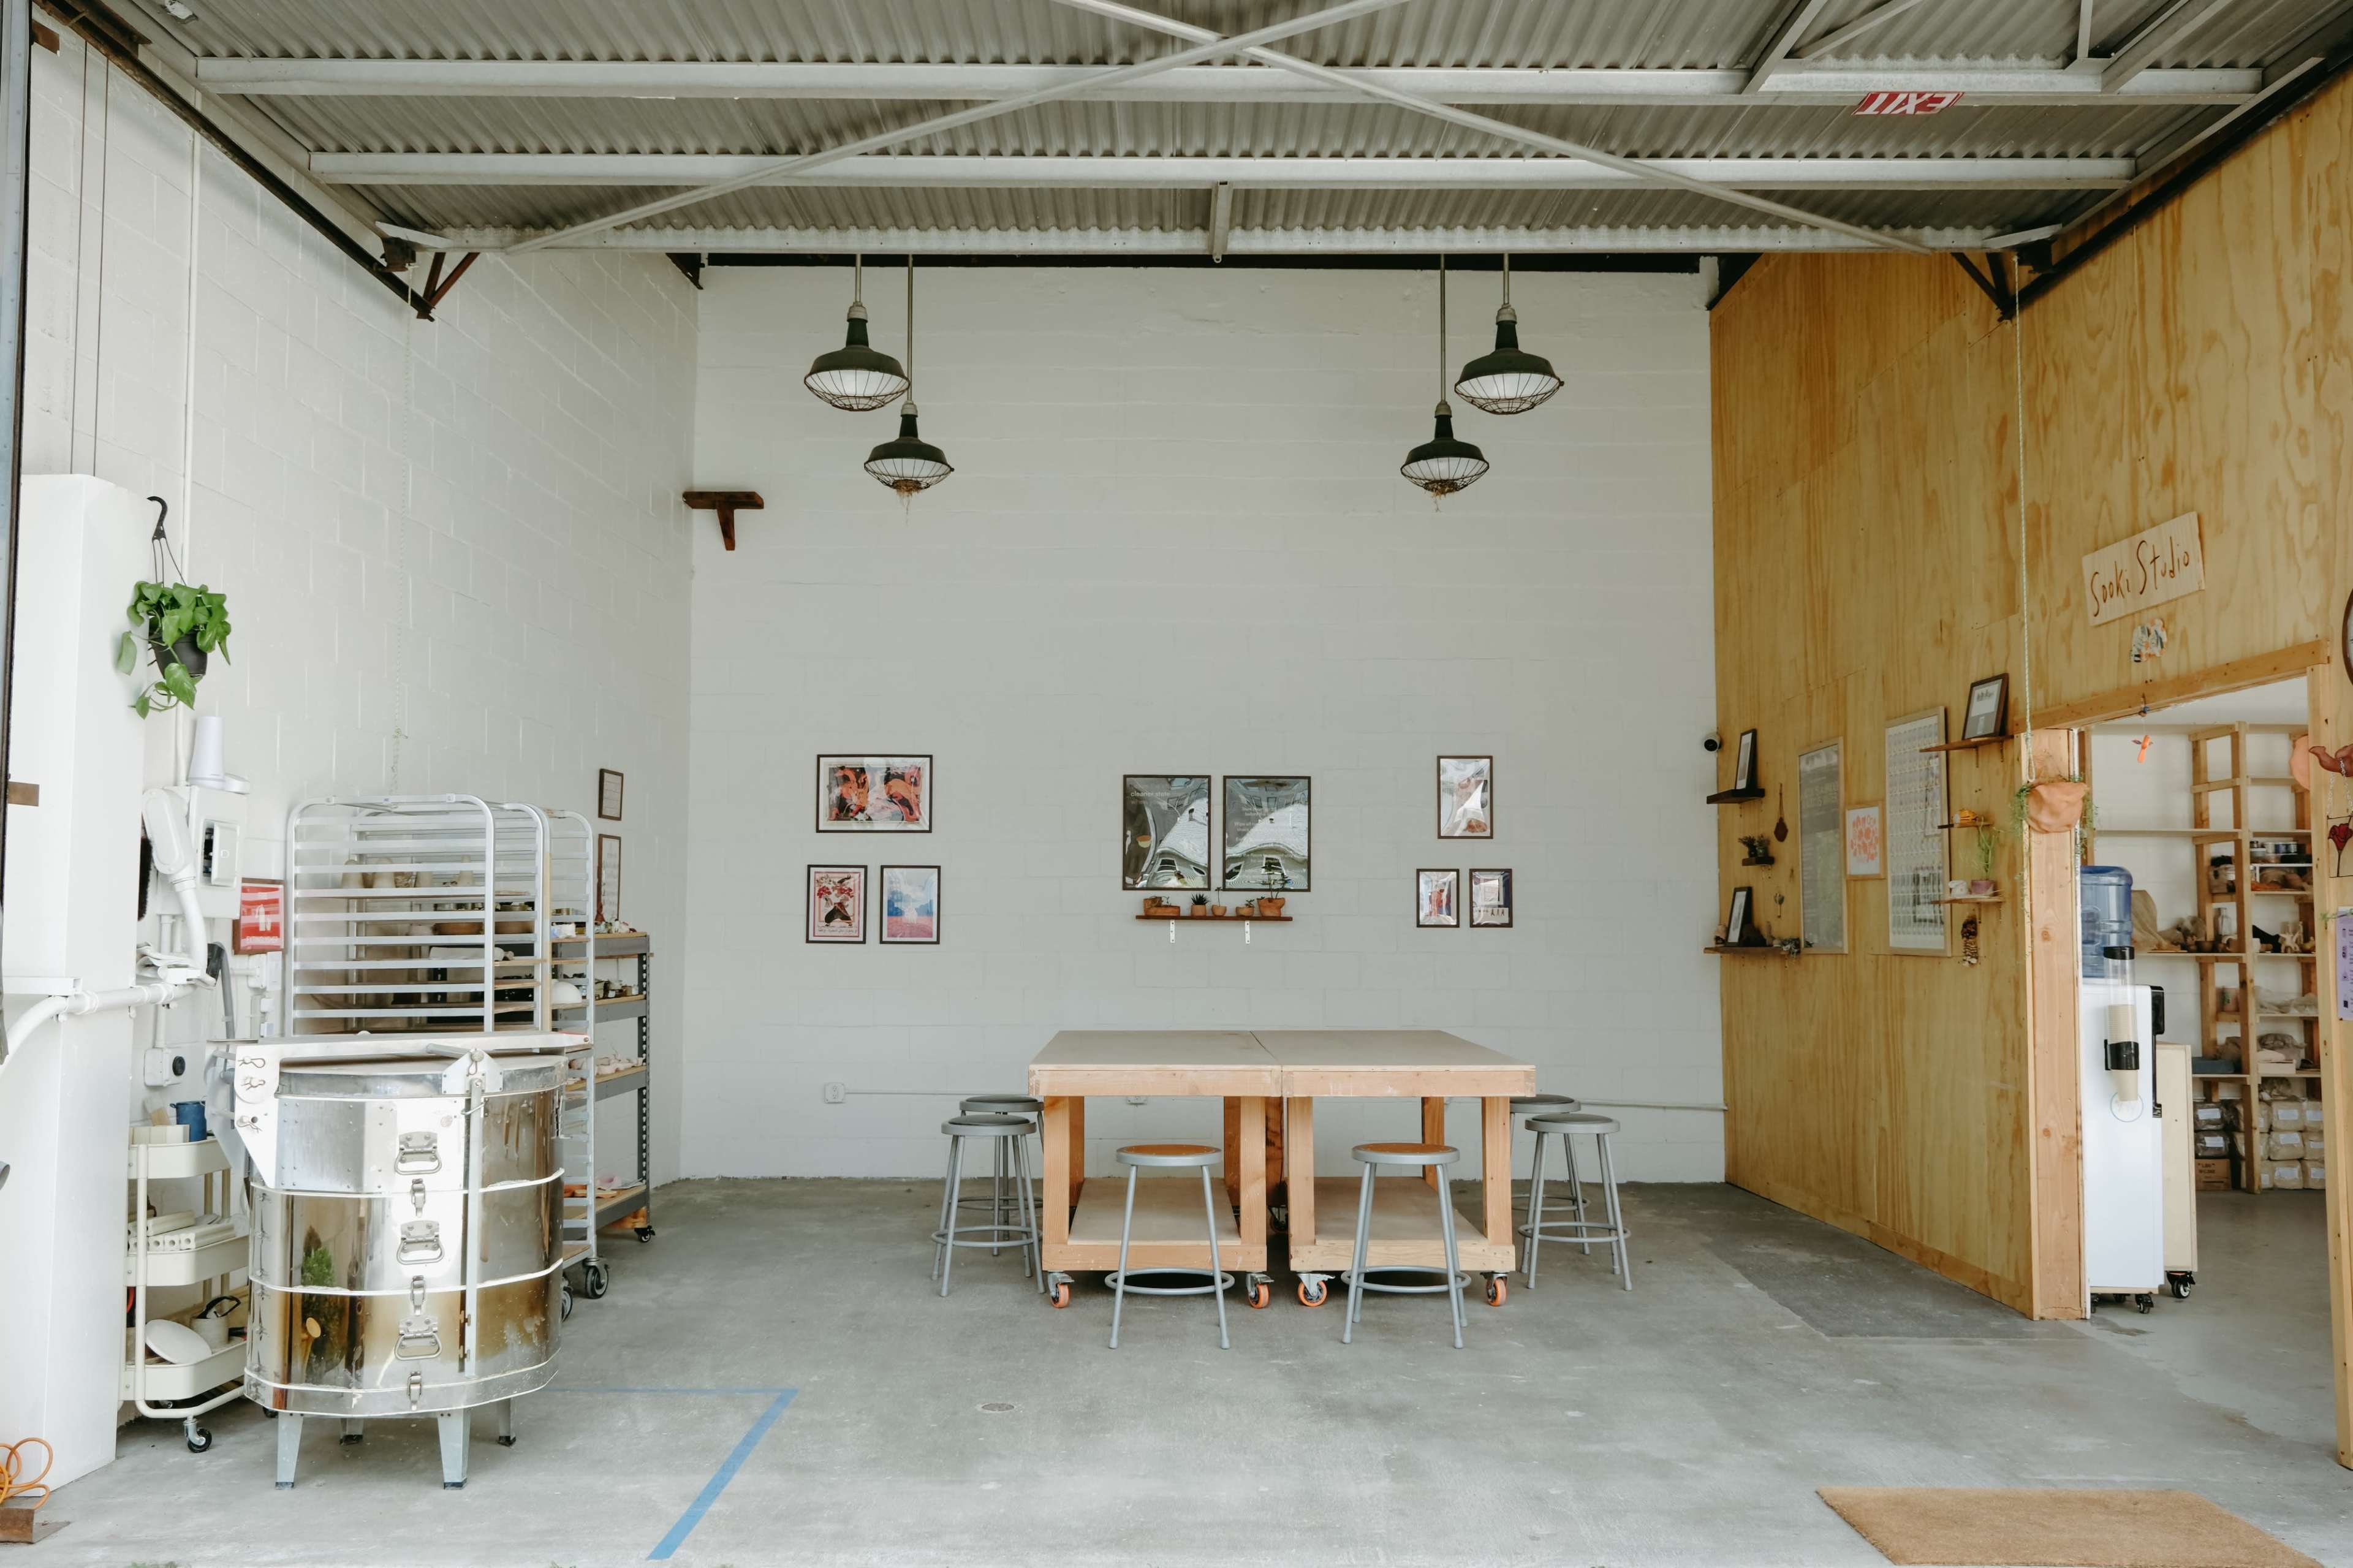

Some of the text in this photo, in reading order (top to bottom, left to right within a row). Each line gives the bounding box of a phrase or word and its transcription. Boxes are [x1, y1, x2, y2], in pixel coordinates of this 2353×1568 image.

[1852, 93, 1960, 115] EXIT
[2090, 536, 2190, 617] Sooki Studio
